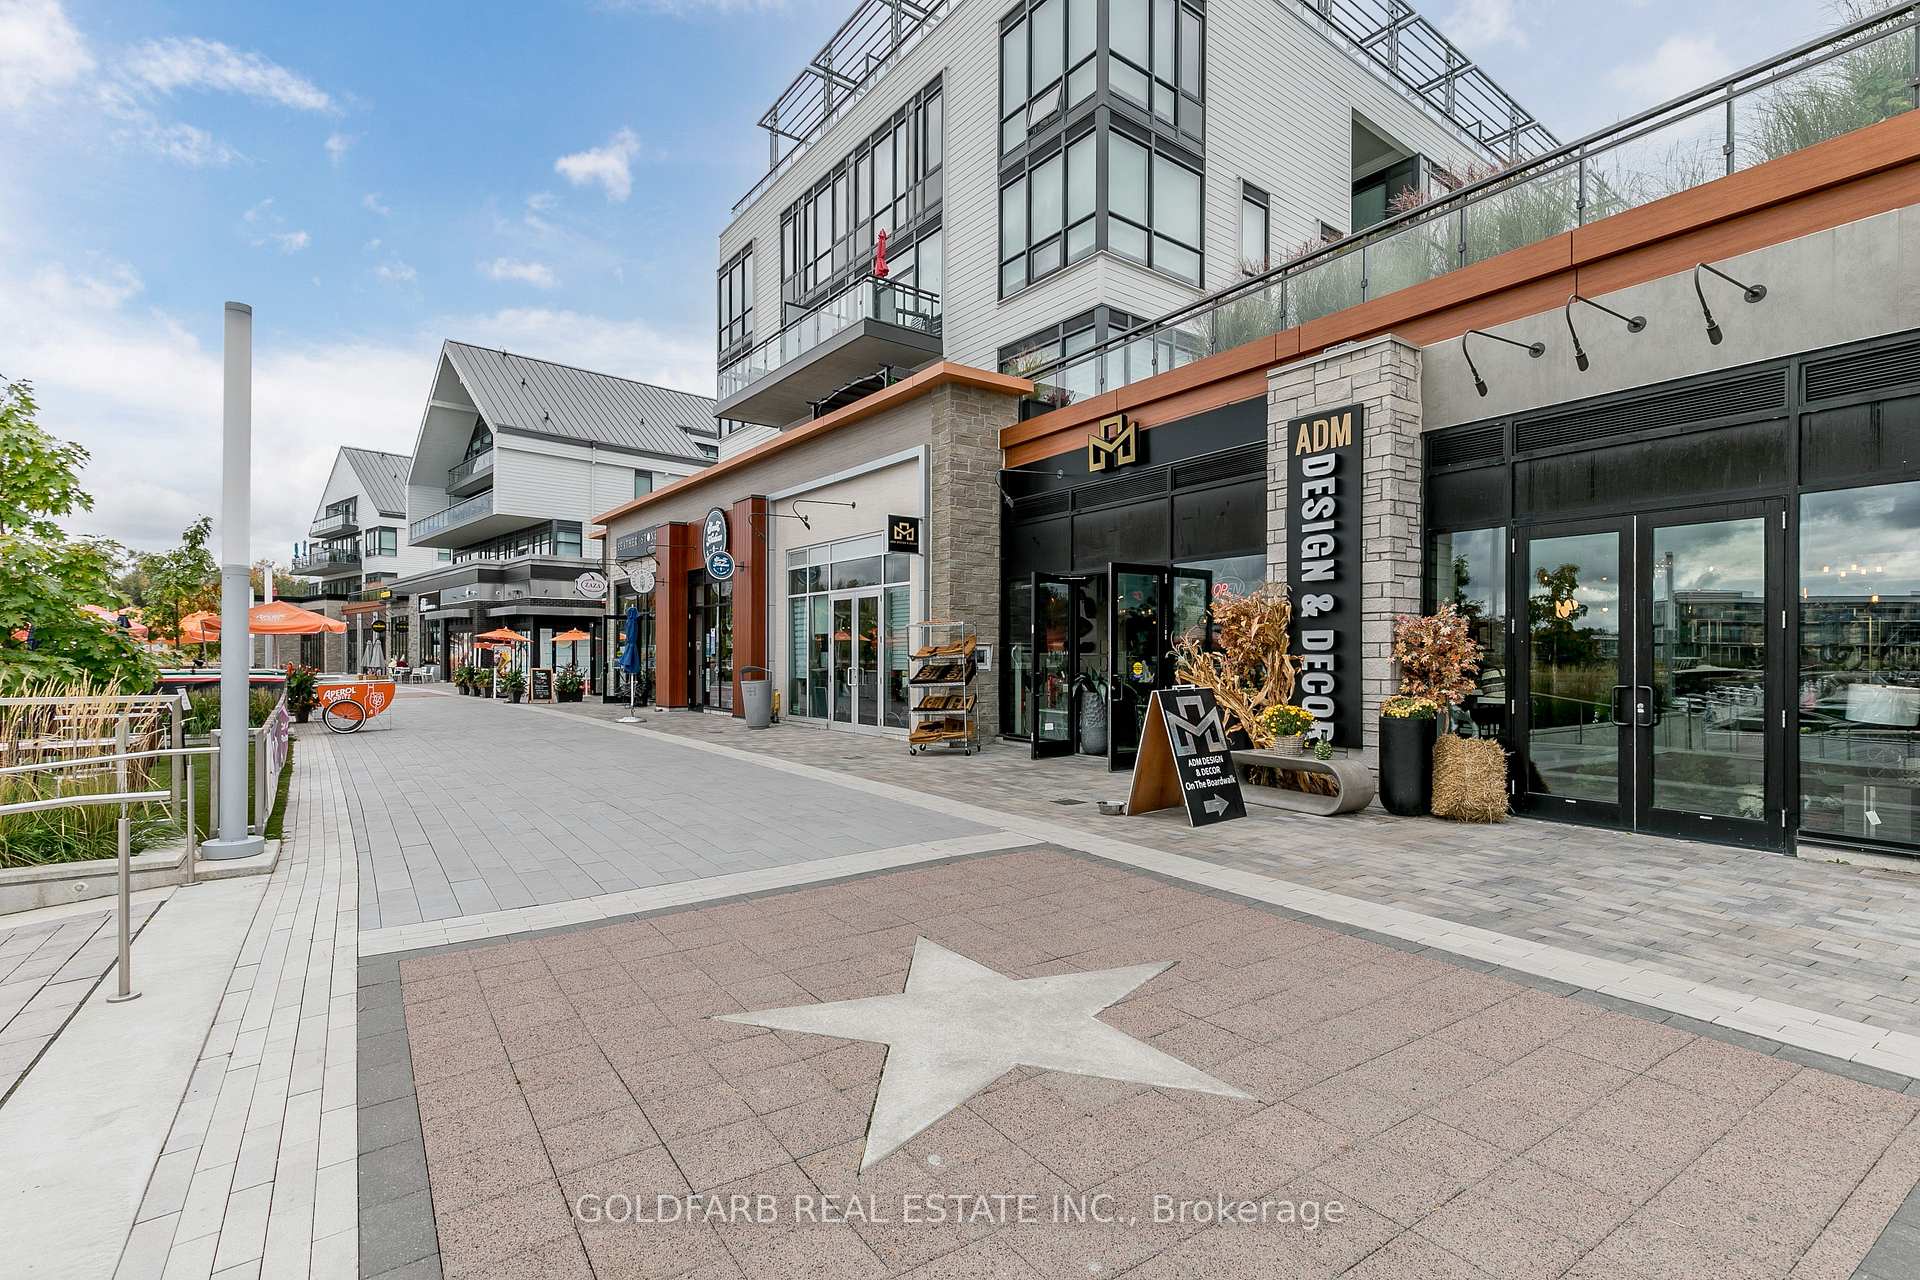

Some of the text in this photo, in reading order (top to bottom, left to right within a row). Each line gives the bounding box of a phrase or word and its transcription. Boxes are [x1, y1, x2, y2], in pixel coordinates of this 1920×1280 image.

[1295, 412, 1352, 457] ADM
[1301, 452, 1336, 582] DESIGN
[1213, 582, 1242, 596] OPEN
[1301, 593, 1335, 617] &
[323, 686, 356, 700] APEROL
[1188, 754, 1224, 767] ADM DESIGN
[1195, 766, 1221, 777] & DECOR
[1185, 774, 1236, 790] On The Boardwalk
